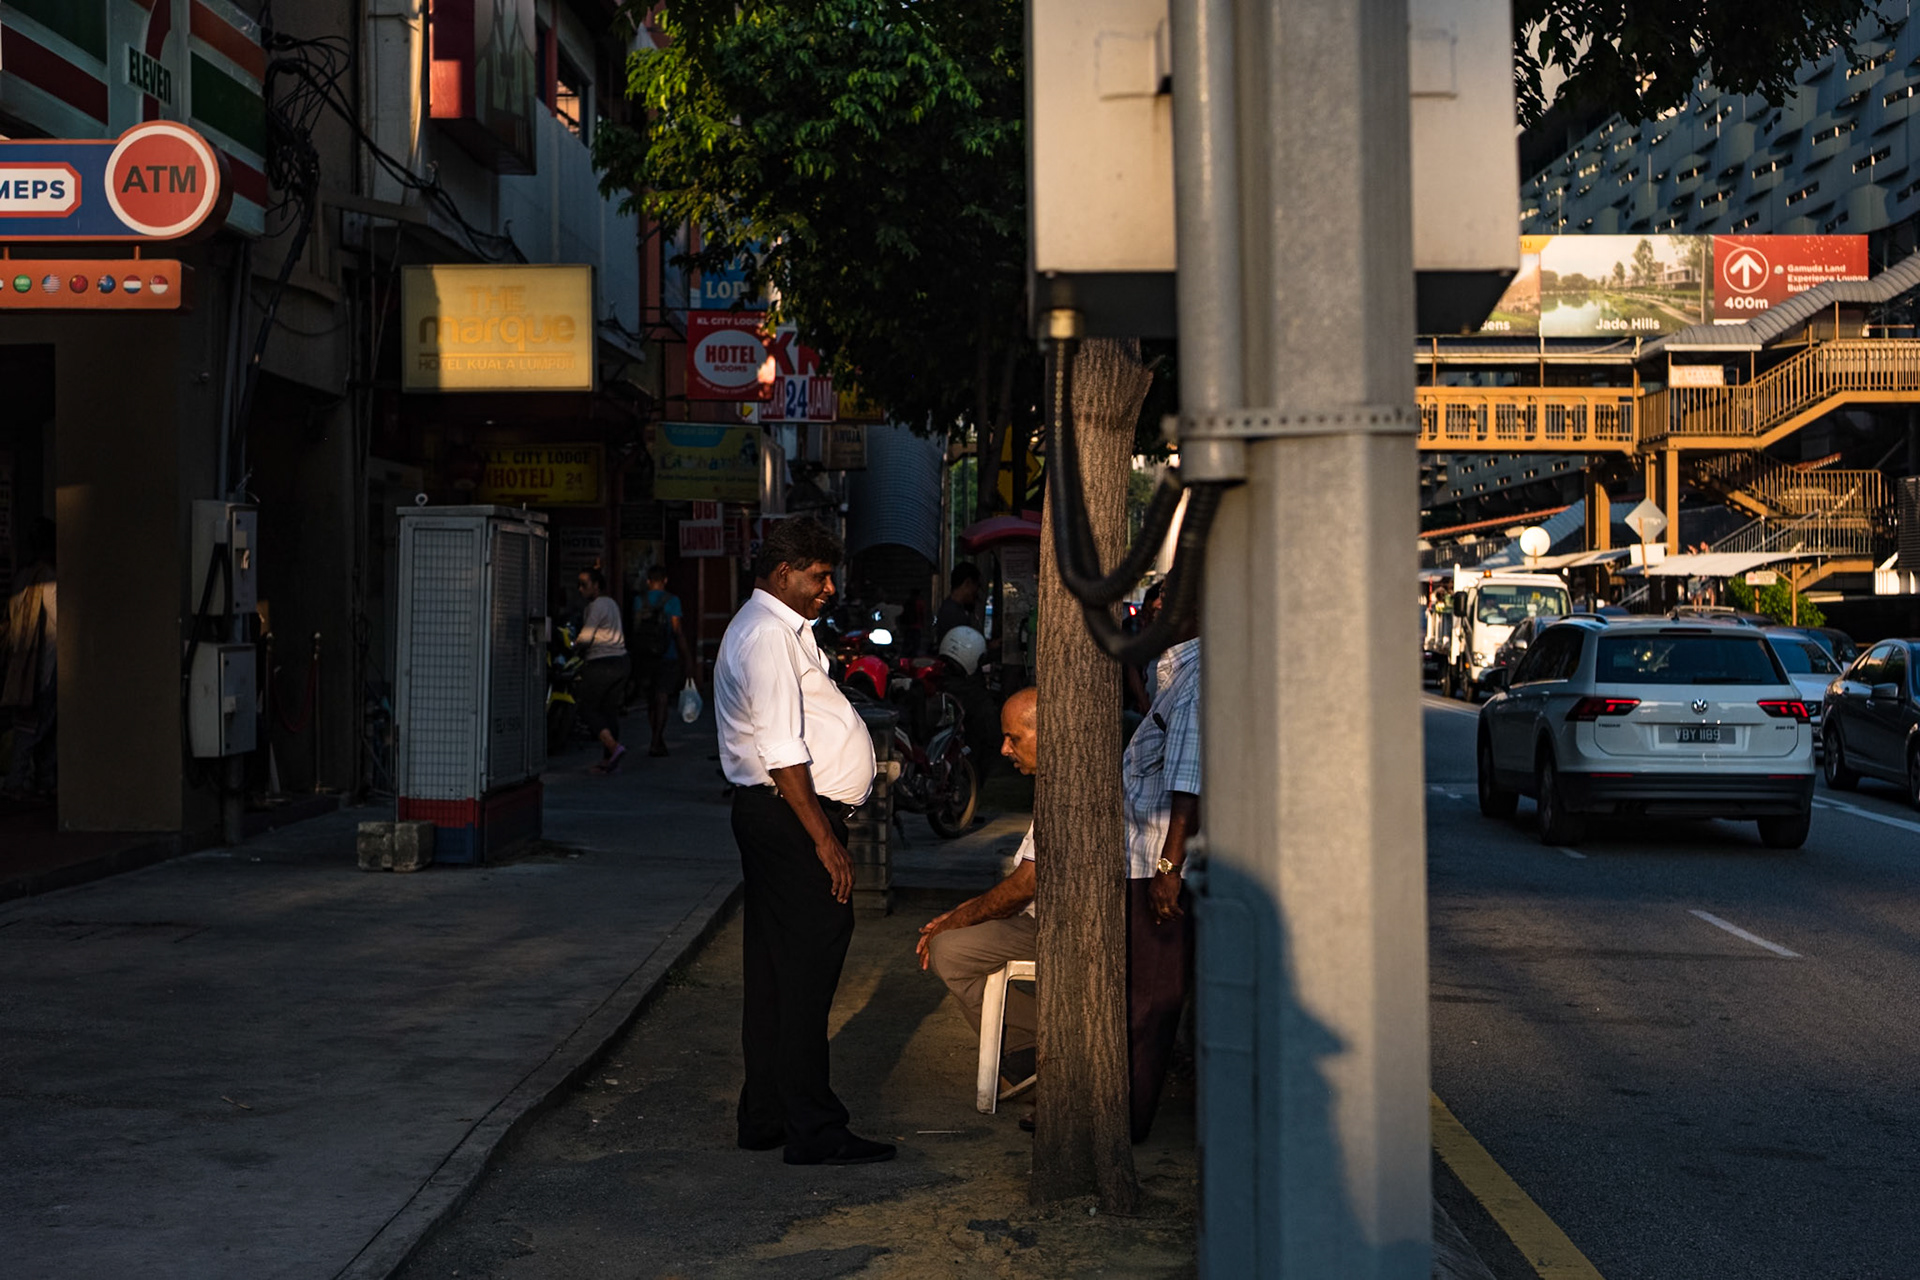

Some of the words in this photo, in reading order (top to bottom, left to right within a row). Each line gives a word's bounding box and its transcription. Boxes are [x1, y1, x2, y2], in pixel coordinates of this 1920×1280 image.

[121, 165, 197, 194] ATM
[0, 180, 65, 199] MEPS
[1787, 264, 1823, 273] Gamuda
[1825, 264, 1846, 273] Land
[465, 285, 526, 311] THE
[1724, 296, 1768, 309] 400m
[711, 317, 732, 325] CITY
[1595, 317, 1627, 331] Jade
[1631, 317, 1661, 331] Hills
[418, 314, 576, 352] marque
[705, 345, 757, 363] HOTEL
[418, 359, 463, 370] HOTEL
[467, 359, 516, 370] KUALA
[786, 379, 807, 418] 24
[513, 451, 542, 464] CITY
[547, 451, 589, 464] LODGE
[1674, 728, 1697, 741] VBY
